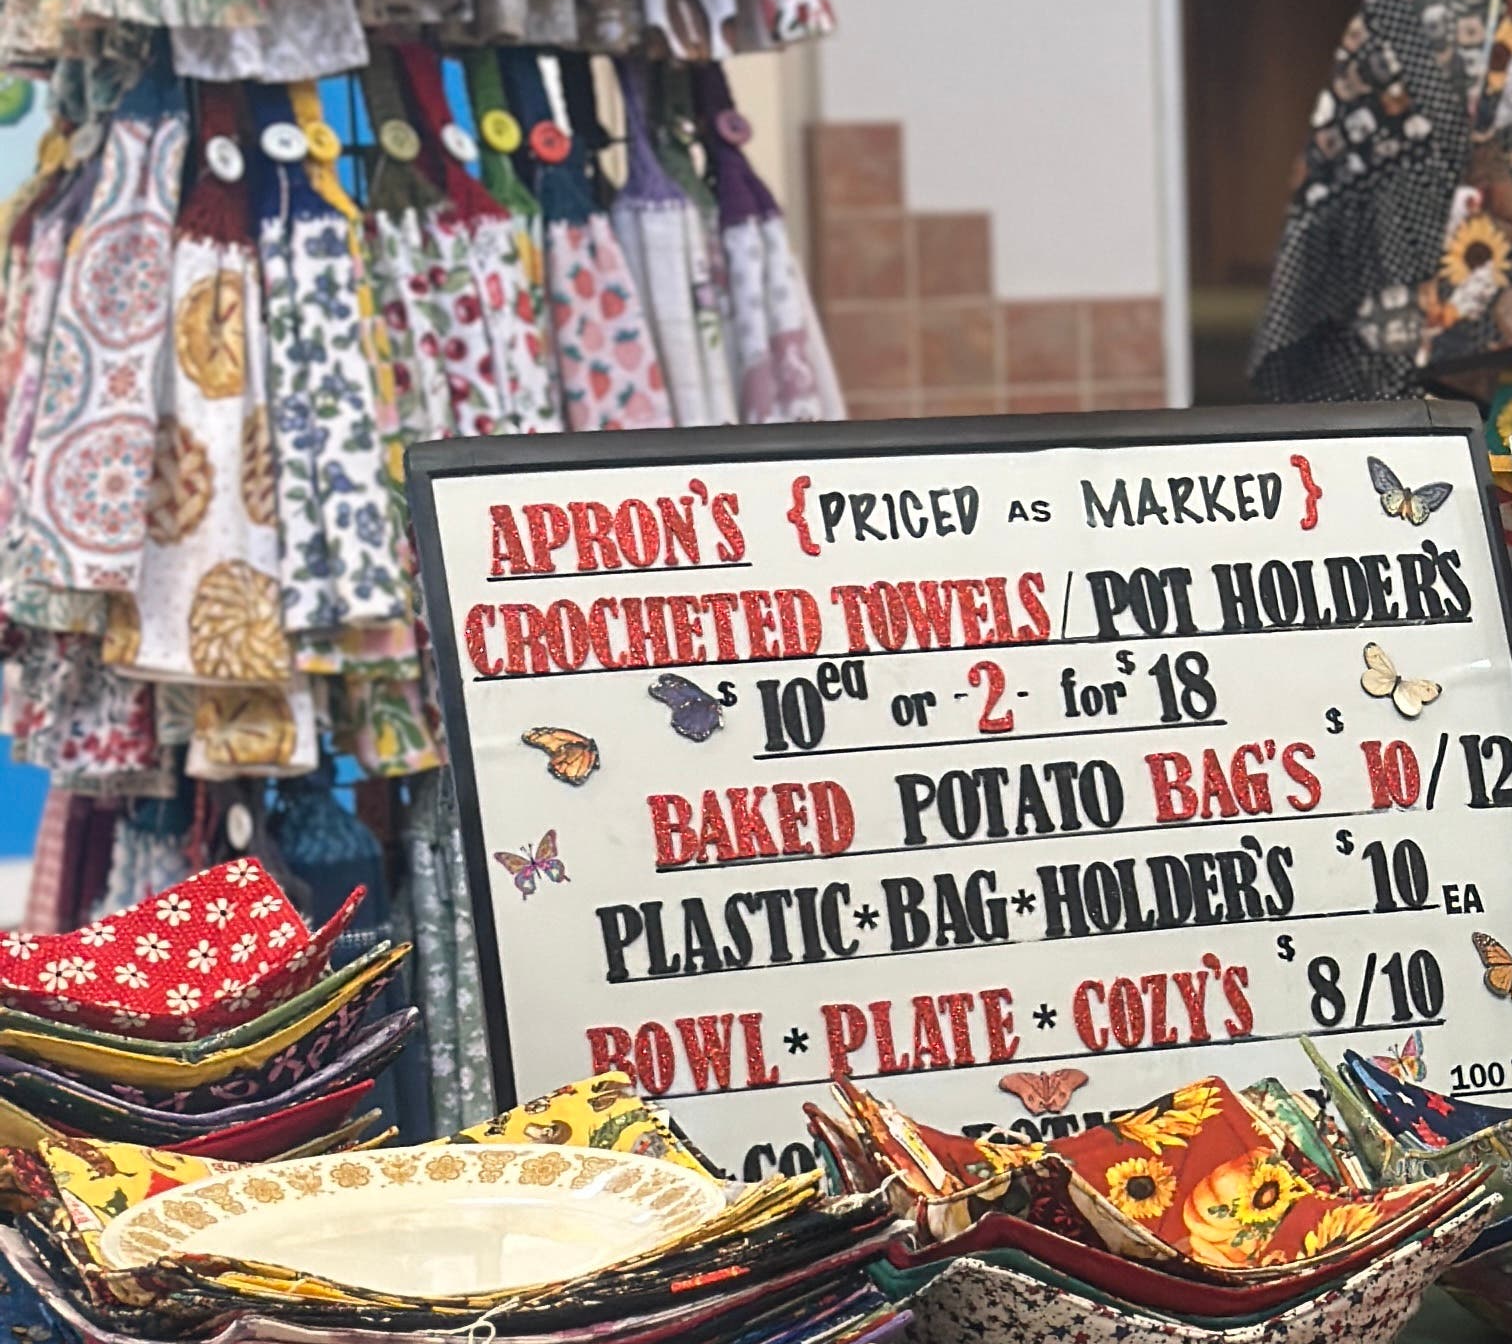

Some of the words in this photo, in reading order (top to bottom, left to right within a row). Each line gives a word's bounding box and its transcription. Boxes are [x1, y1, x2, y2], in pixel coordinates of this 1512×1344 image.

[489, 478, 746, 576] APRON'S
[1007, 499, 1051, 522] AS
[465, 588, 823, 677] CROCHETED
[1212, 539, 1471, 630] HOLDER'S
[892, 684, 937, 728] or
[1060, 669, 1127, 719] for
[647, 779, 855, 867] BAKED
[895, 759, 1124, 846] POTATO
[1145, 738, 1322, 823] BAG'S
[1442, 883, 1485, 916] EA
[586, 1011, 779, 1096] BOWL
[820, 987, 1020, 1080] PLATE
[1071, 952, 1255, 1052] COZY'S
